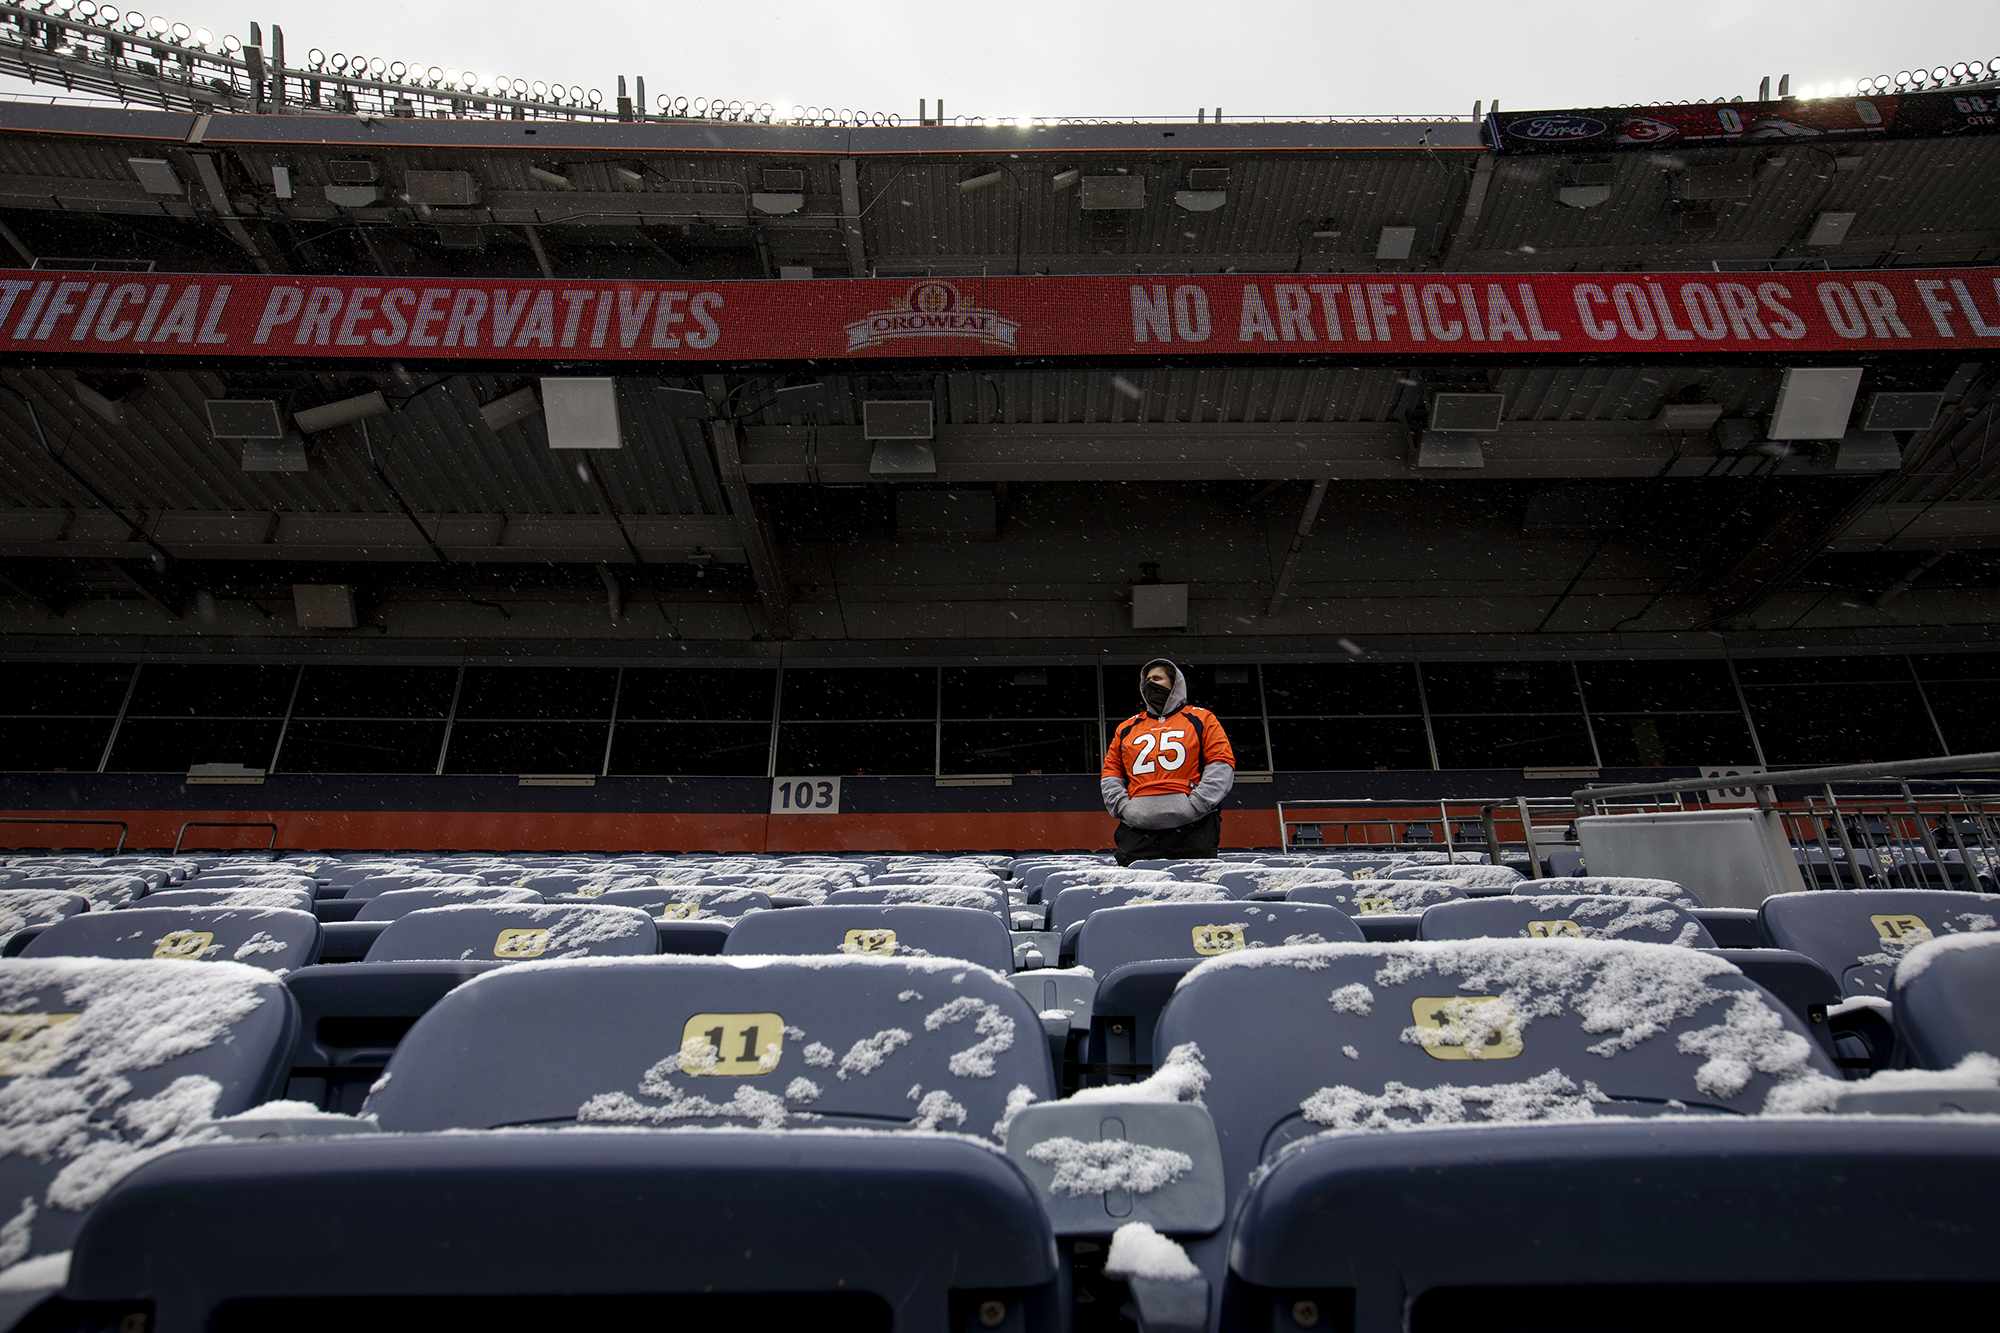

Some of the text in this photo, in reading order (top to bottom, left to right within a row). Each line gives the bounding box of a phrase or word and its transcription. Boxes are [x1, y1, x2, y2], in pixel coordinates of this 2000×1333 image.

[1717, 108, 1744, 133] 0
[1855, 101, 1882, 125] 0
[1966, 115, 1996, 126] QTR
[1527, 119, 1588, 137] Ford
[0, 280, 725, 349] TIFICIAL PRESERVATIVES
[874, 315, 990, 331] OROWEAT
[1130, 277, 2000, 343] NO ARTIFICIAL COLORS OR FL
[1132, 730, 1186, 775] 25
[778, 781, 834, 809] 103
[1707, 770, 1770, 798] 10
[702, 1026, 762, 1063] 11
